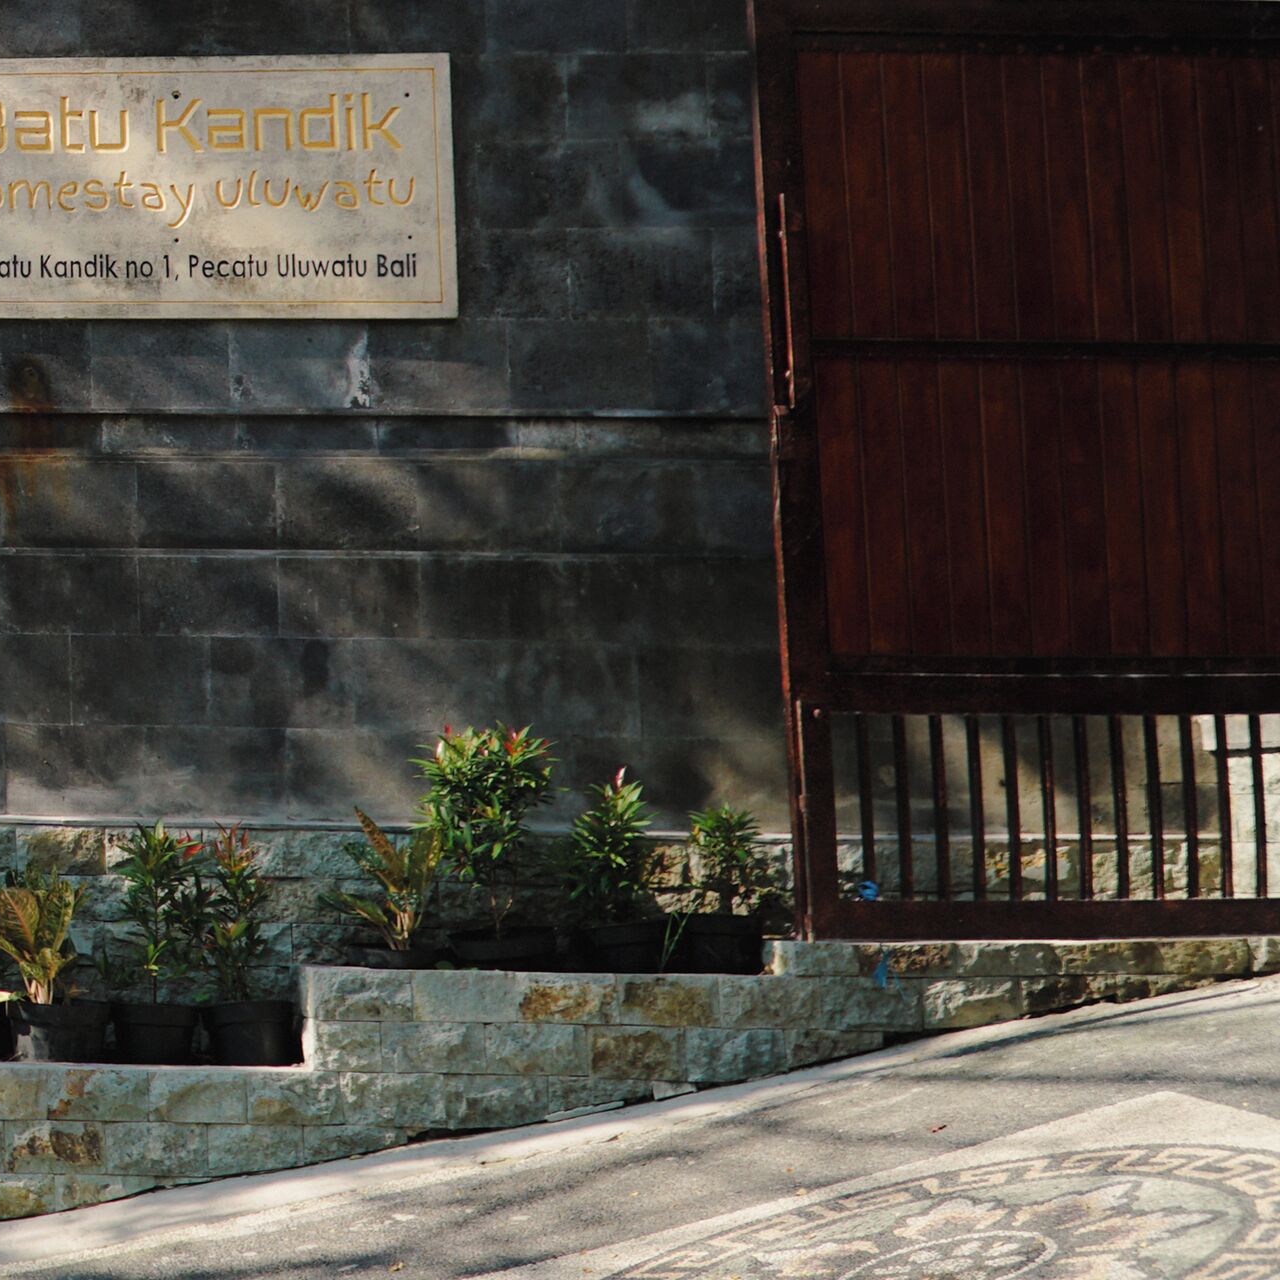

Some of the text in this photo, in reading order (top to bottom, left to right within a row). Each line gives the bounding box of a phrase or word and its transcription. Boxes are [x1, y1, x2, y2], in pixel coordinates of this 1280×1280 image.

[155, 91, 403, 153] Kandik
[215, 169, 416, 211] uluwatu
[40, 254, 119, 279] Kandik
[126, 261, 154, 279] no
[162, 254, 180, 282] 1,
[188, 254, 268, 279] Pecatu
[277, 253, 368, 278] Uluwatu
[376, 253, 418, 278] Bali
